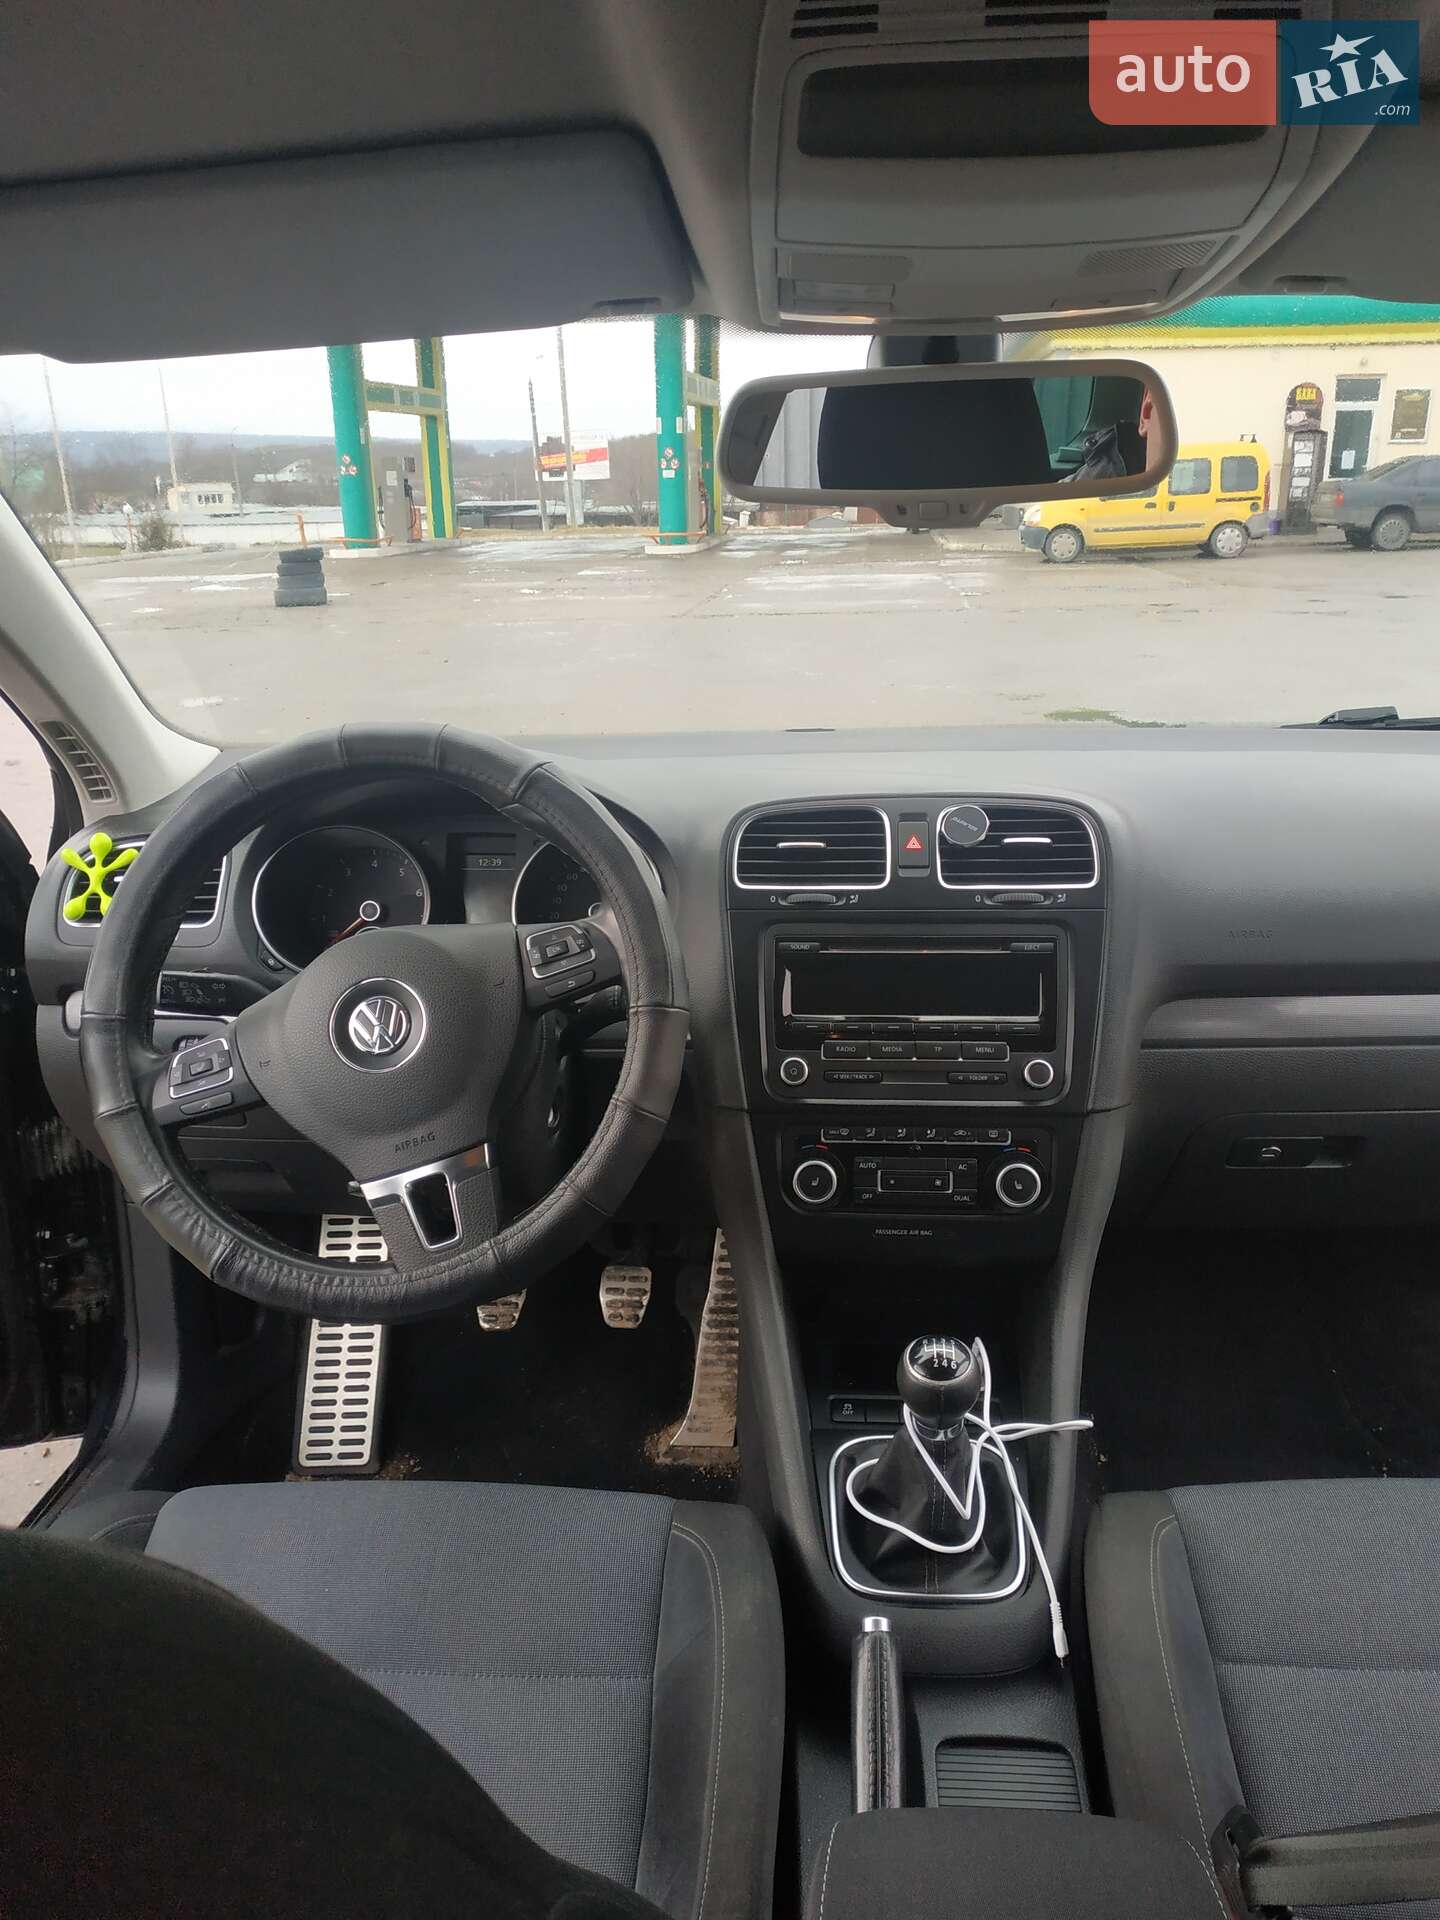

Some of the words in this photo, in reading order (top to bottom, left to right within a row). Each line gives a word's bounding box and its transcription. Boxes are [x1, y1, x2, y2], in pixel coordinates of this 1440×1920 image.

[478, 858, 503, 867] 12:39
[415, 888, 423, 897] 6
[975, 1046, 995, 1054] MENU
[394, 1131, 436, 1153] AIRBAG
[953, 1194, 971, 1202] DUAL
[933, 1359, 939, 1368] 2
[941, 1359, 948, 1368] 4
[950, 1360, 957, 1369] 6
